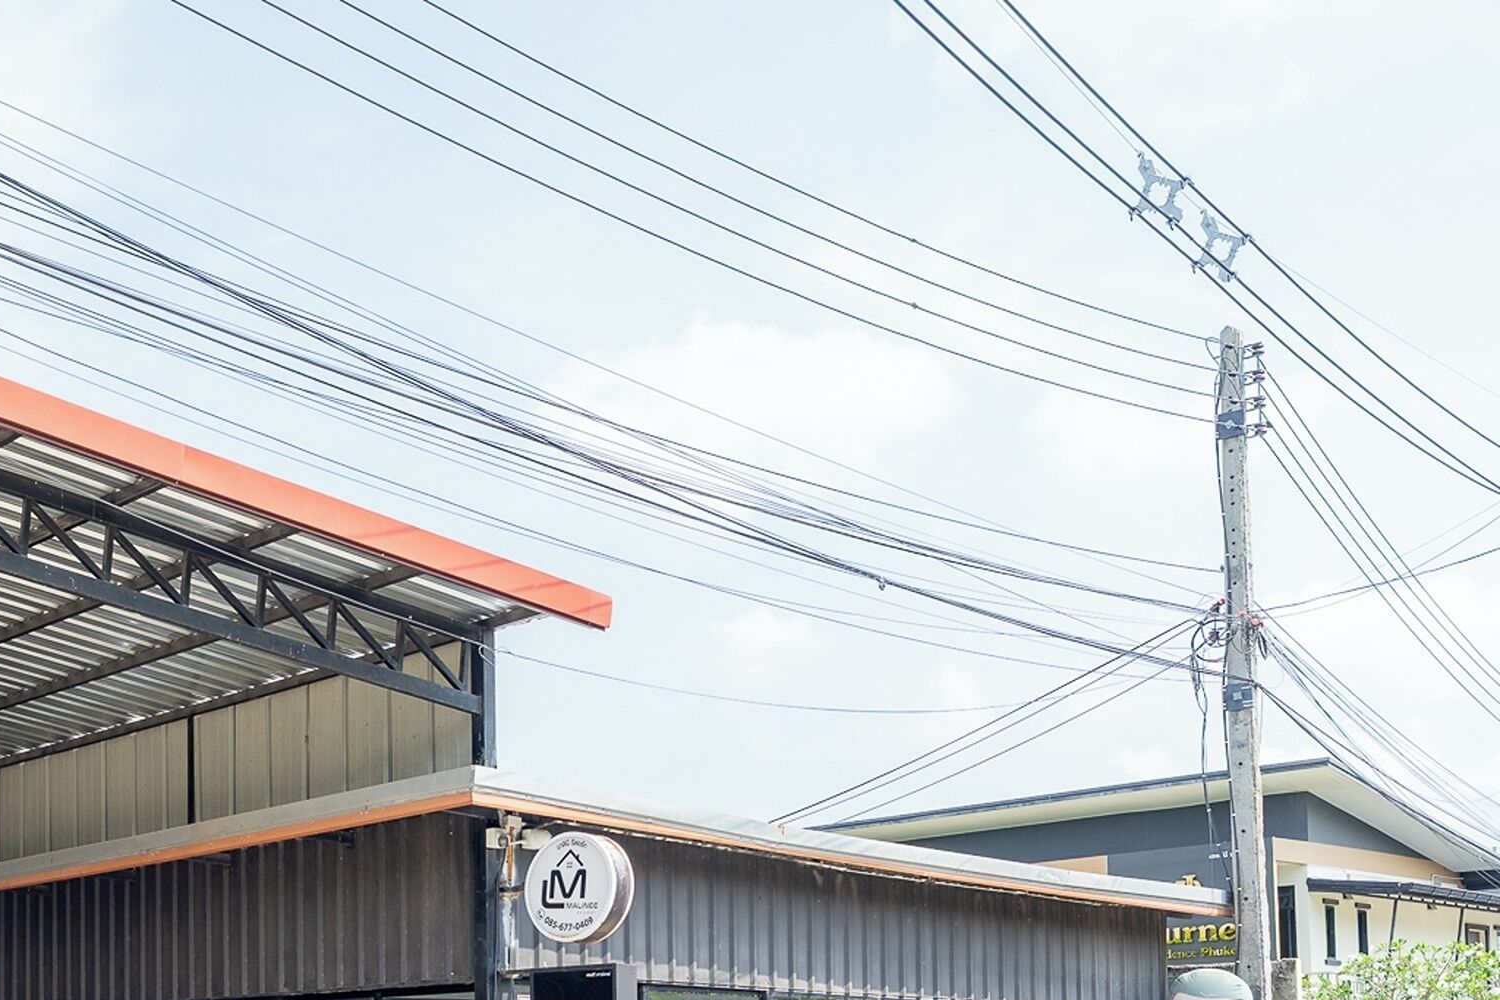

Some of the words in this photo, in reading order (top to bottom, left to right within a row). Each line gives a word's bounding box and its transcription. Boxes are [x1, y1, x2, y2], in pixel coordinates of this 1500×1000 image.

[1166, 922, 1236, 945] urne
[1166, 949, 1197, 959] dence
[1201, 946, 1236, 957] Phuke
